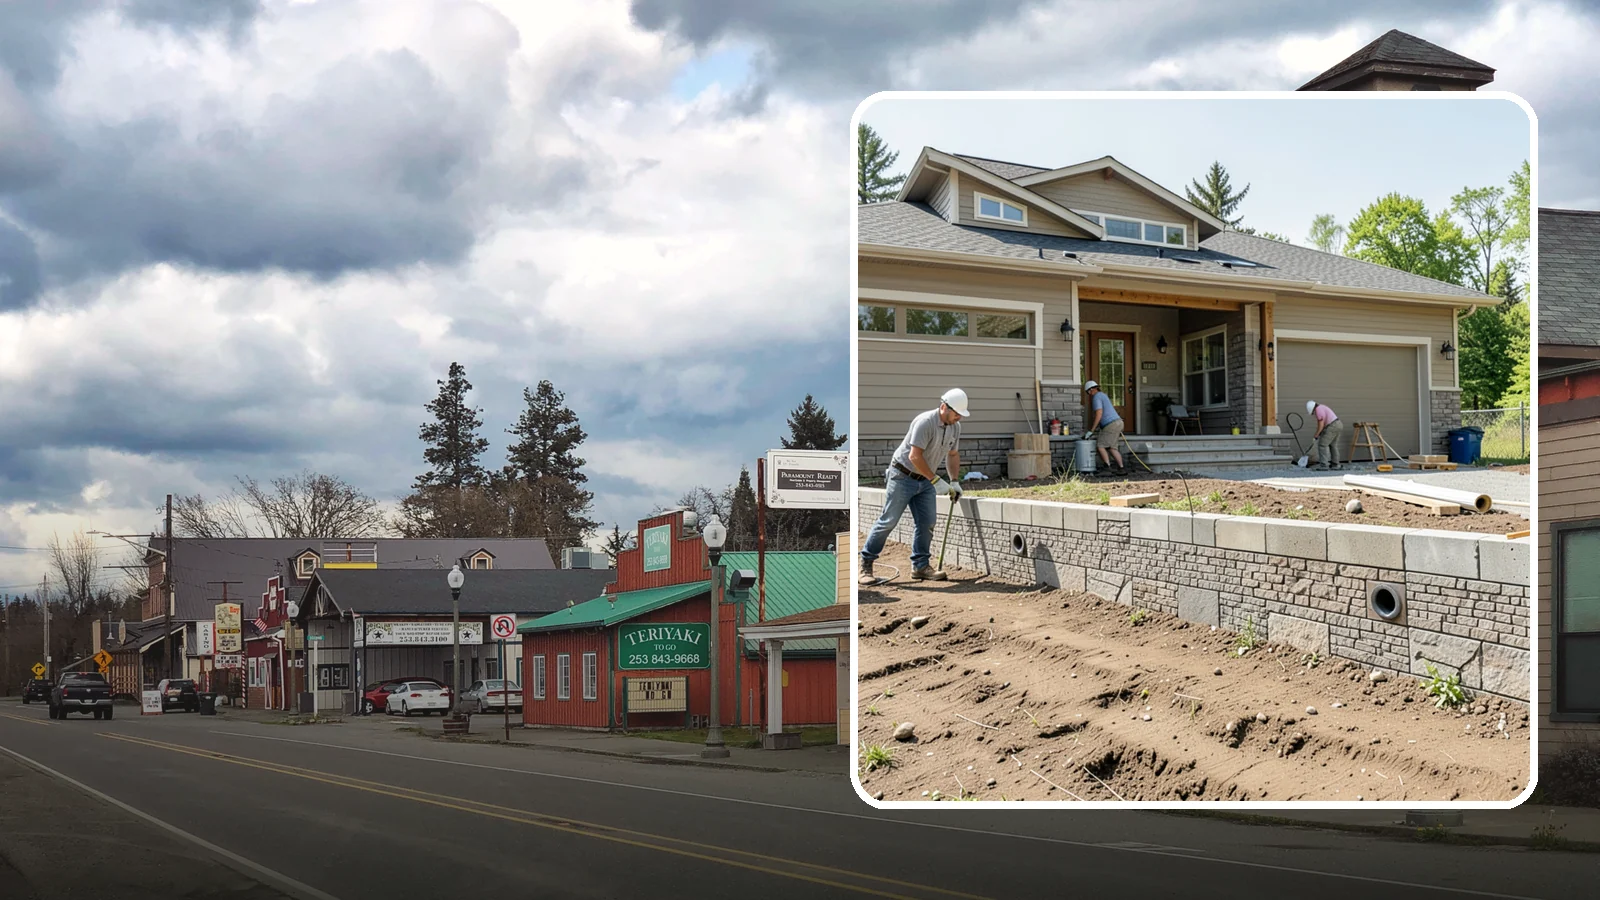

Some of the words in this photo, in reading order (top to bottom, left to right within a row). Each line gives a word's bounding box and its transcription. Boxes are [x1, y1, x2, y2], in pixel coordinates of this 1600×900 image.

[625, 627, 702, 646] TERIYAKI
[629, 654, 648, 664] 253
[652, 654, 700, 664] 843-9668
